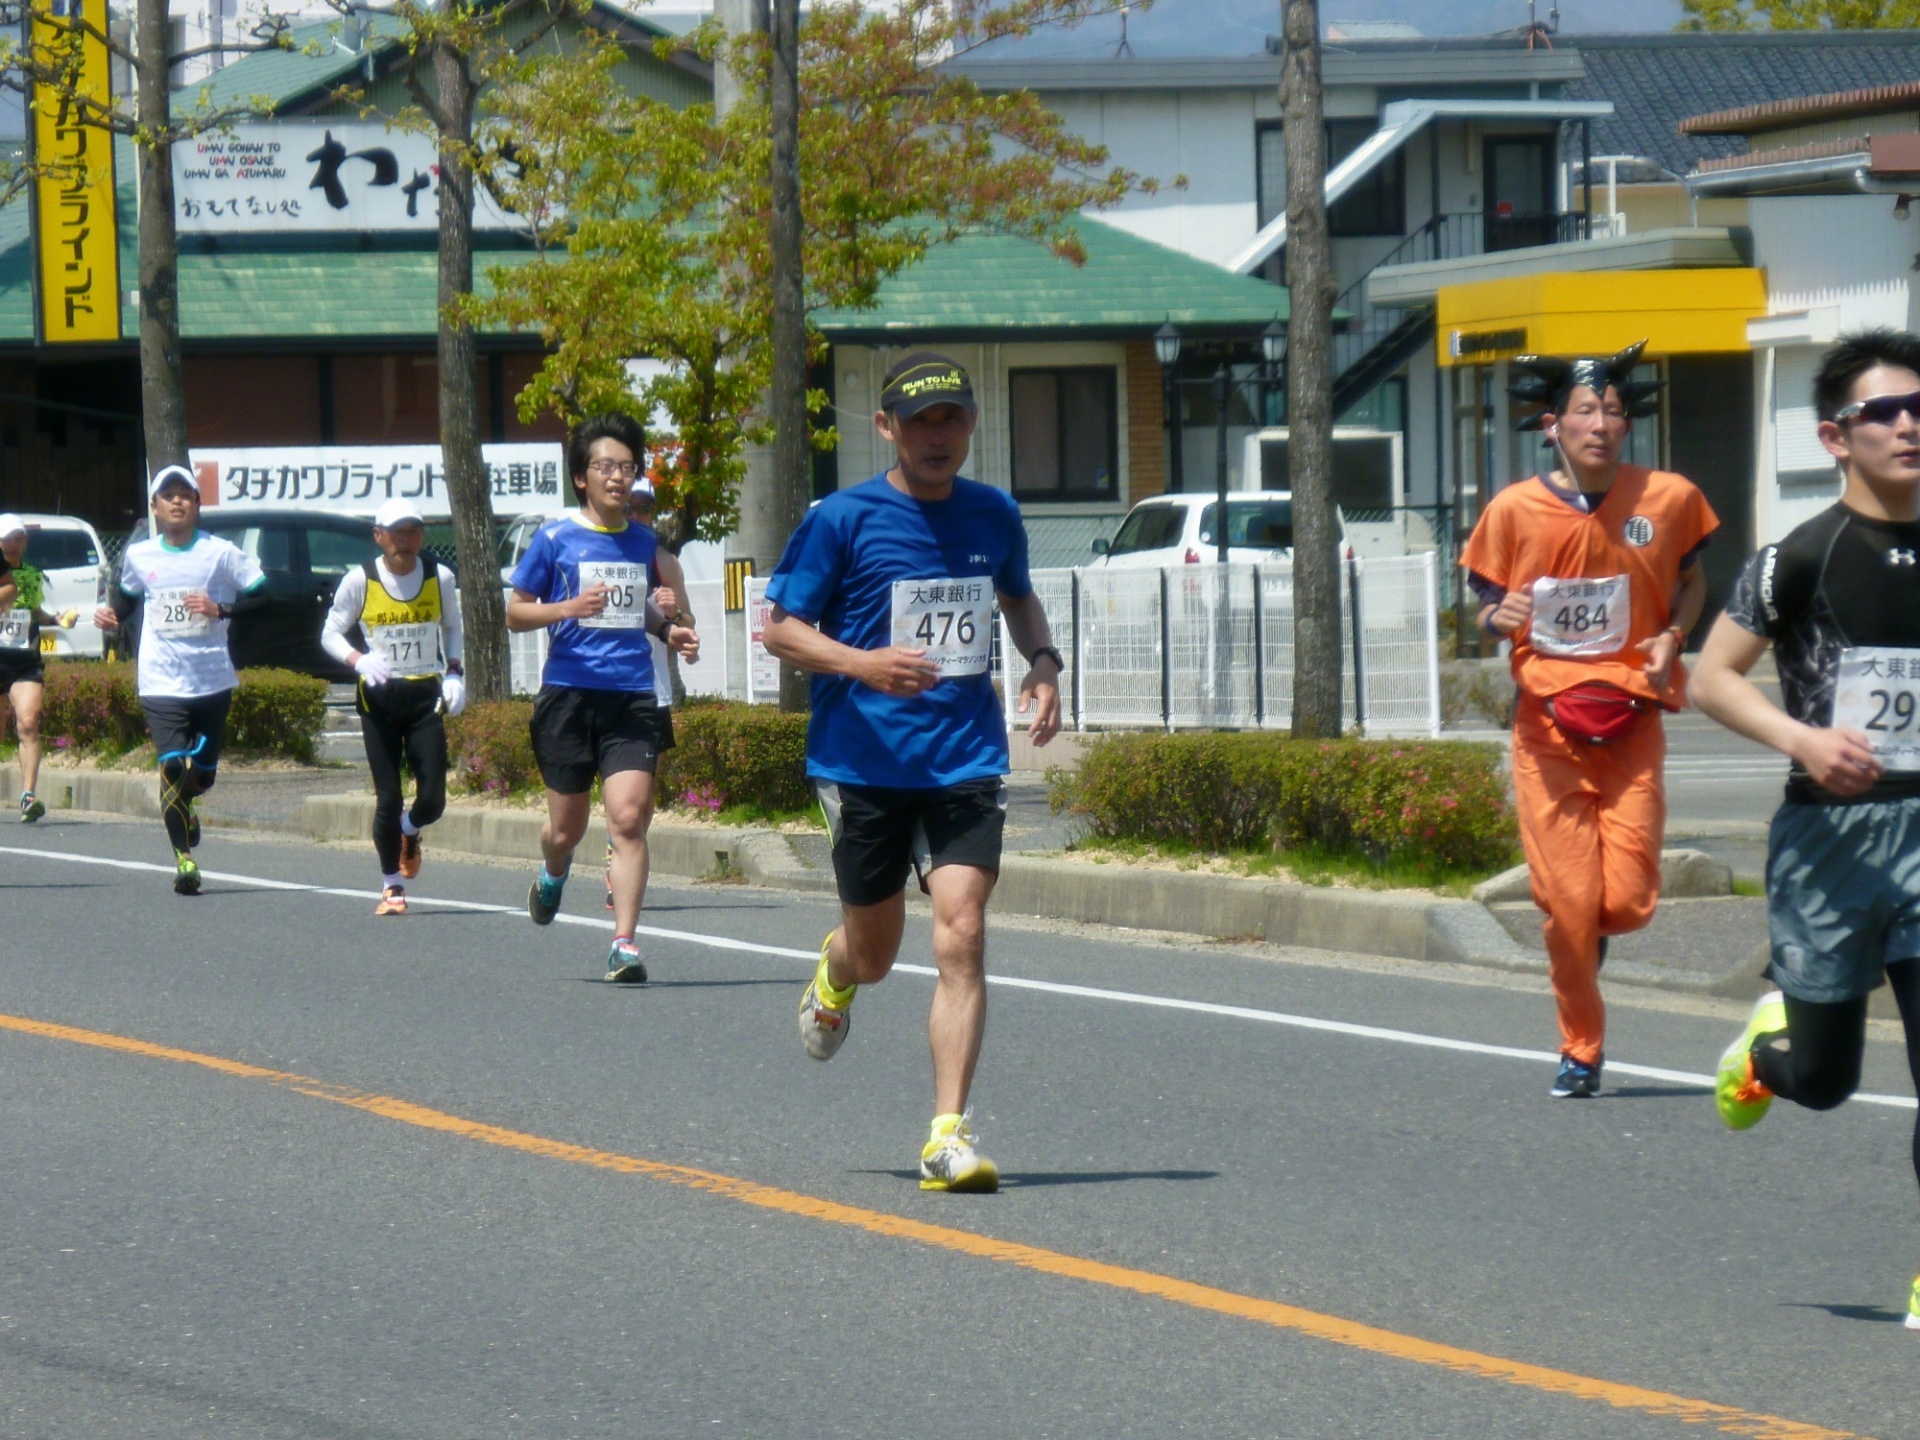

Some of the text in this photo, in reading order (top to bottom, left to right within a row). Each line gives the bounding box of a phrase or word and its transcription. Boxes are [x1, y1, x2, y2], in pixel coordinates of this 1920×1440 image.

[228, 143, 264, 153] GOHAN
[268, 143, 281, 152] TO
[239, 155, 274, 166] OSAKE
[215, 169, 229, 179] GA
[236, 168, 286, 179] ATUMARU
[181, 195, 302, 218] おもてなし処
[902, 379, 925, 393] RUN
[925, 375, 941, 385] TO
[591, 566, 640, 580] 大東銀行
[1761, 546, 1779, 622] ARMOUR
[603, 584, 635, 609] 05
[909, 583, 983, 605] 大東銀行
[915, 609, 976, 647] 476
[1555, 602, 1611, 633] 484
[389, 640, 422, 662] 171
[1865, 688, 1920, 733] 29
